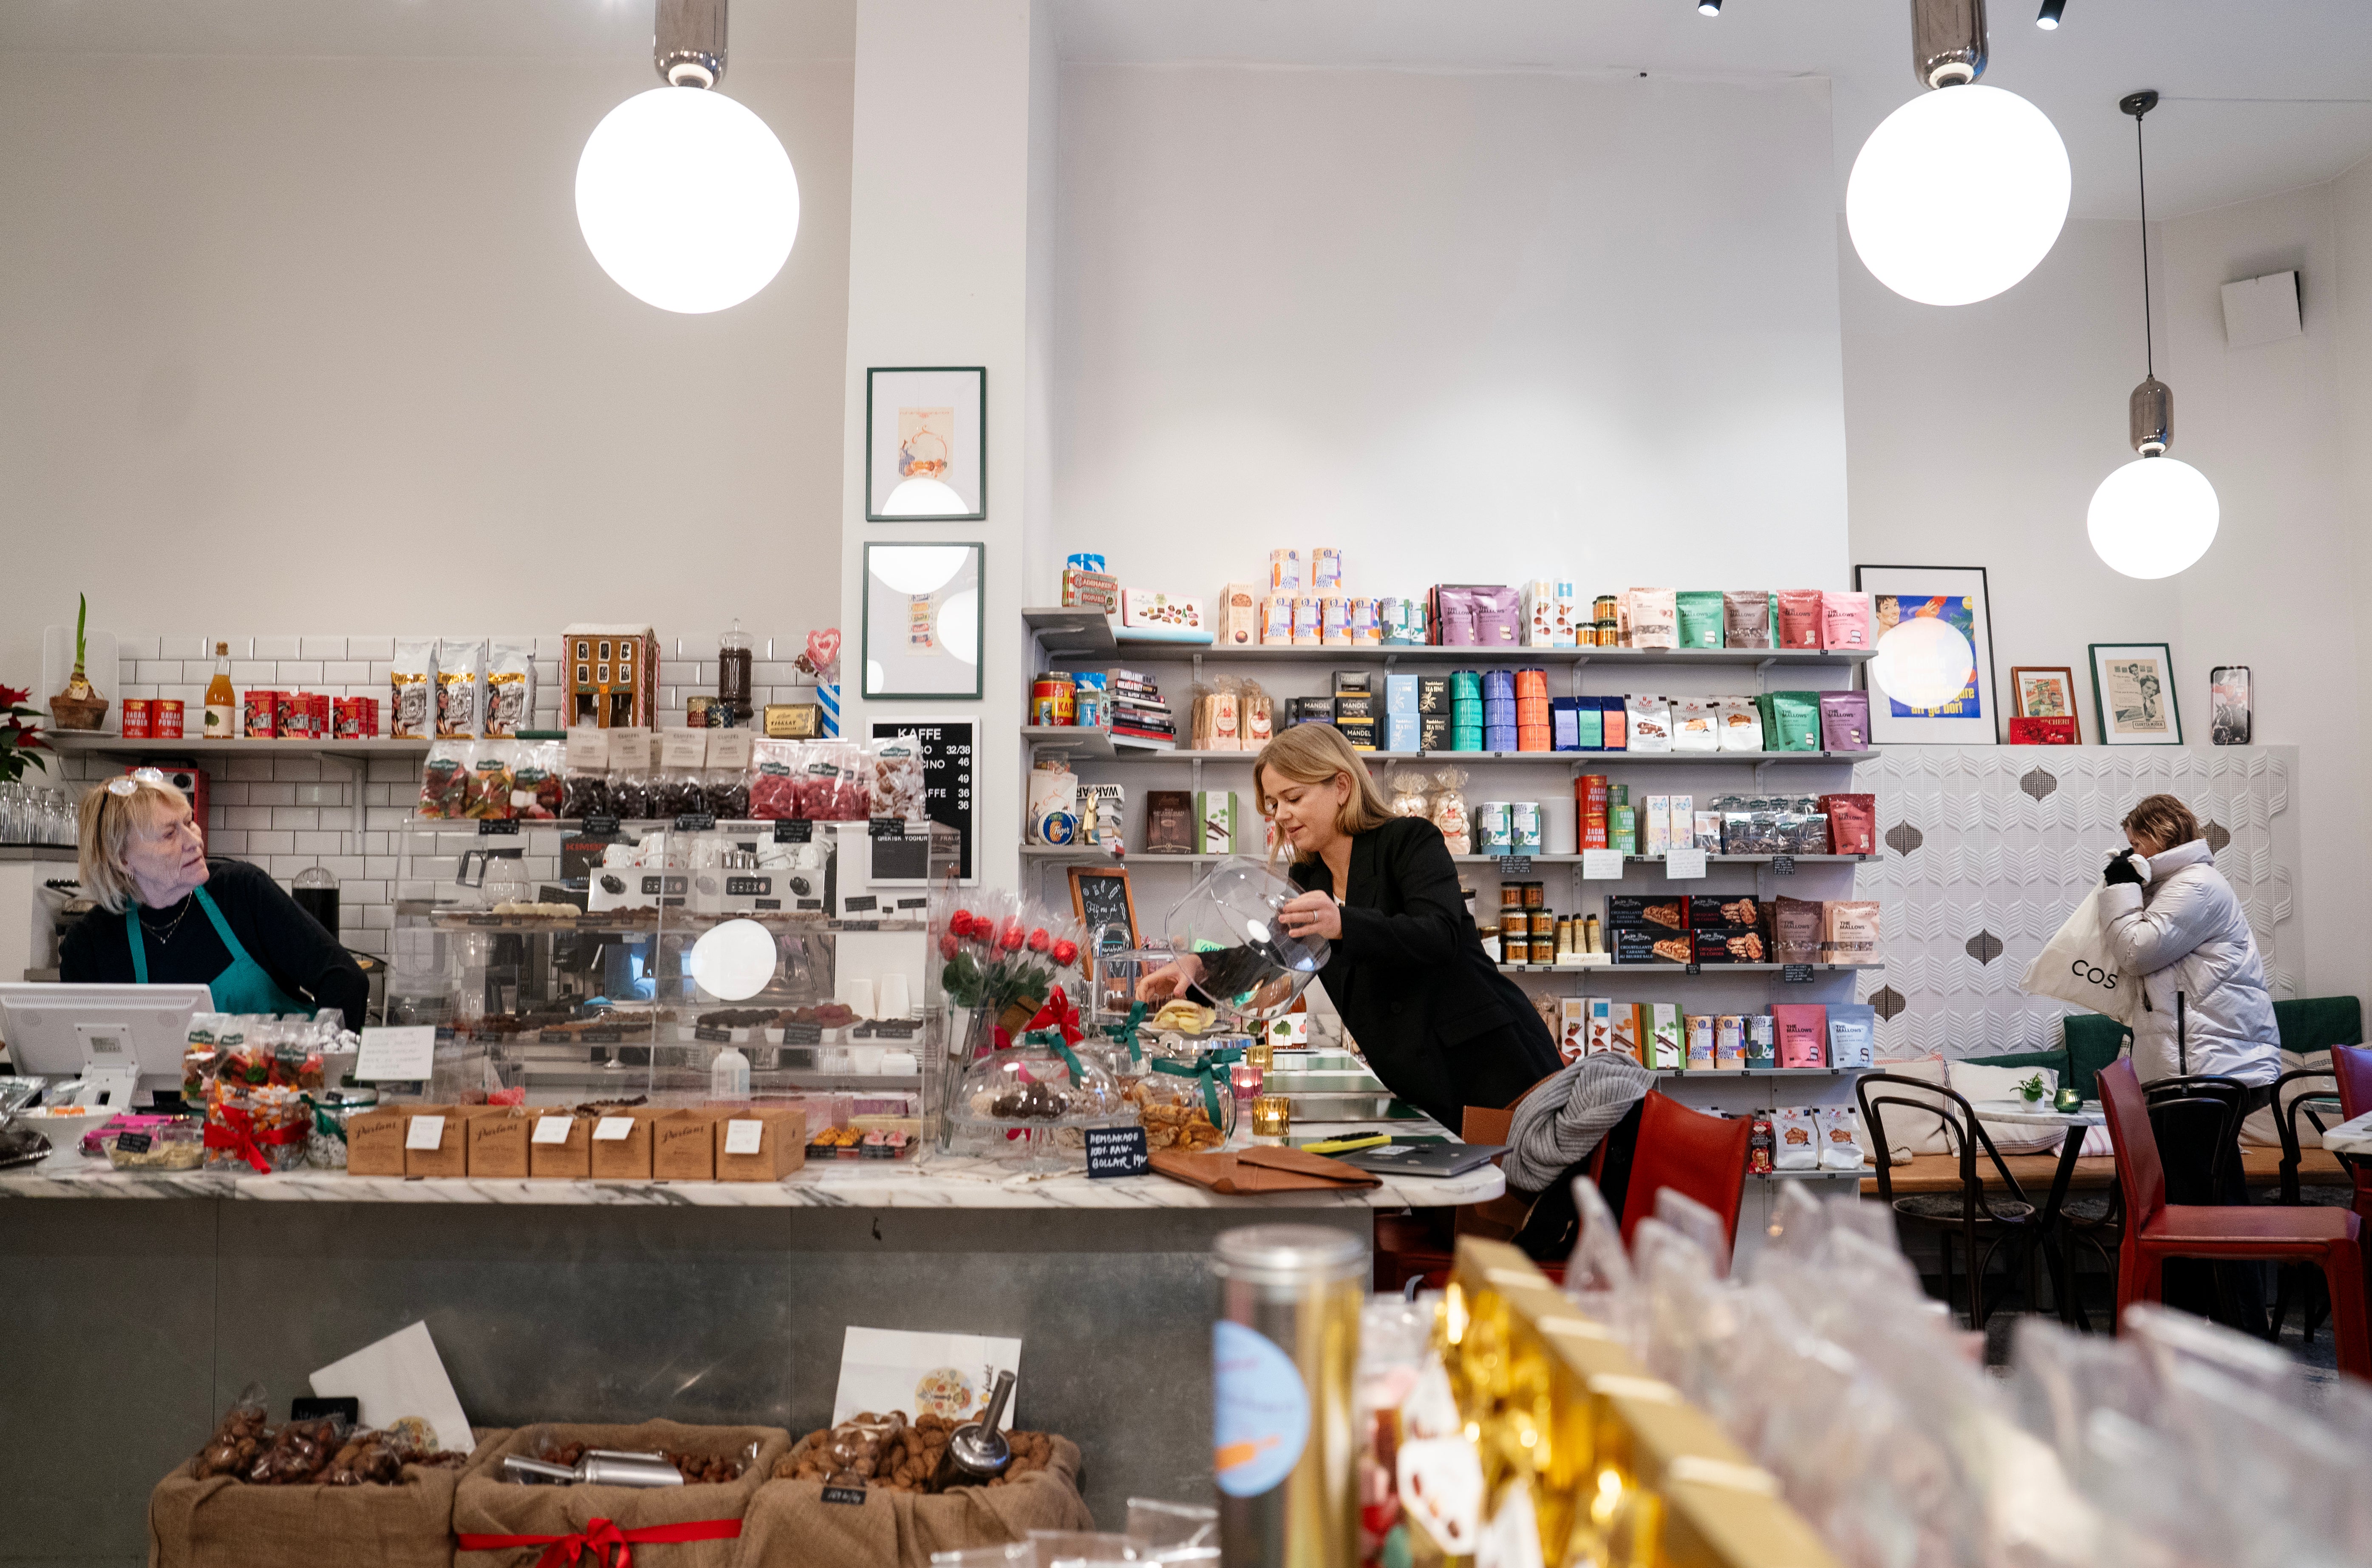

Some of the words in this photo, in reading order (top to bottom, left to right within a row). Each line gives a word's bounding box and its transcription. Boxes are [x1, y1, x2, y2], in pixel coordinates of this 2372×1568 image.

[898, 728, 941, 740] KAFFE
[946, 745, 971, 754] 32/38
[958, 757, 969, 767] 46
[958, 774, 969, 783] 49
[958, 788, 969, 798] 36
[958, 801, 969, 809] 36
[2072, 959, 2118, 989] COS
